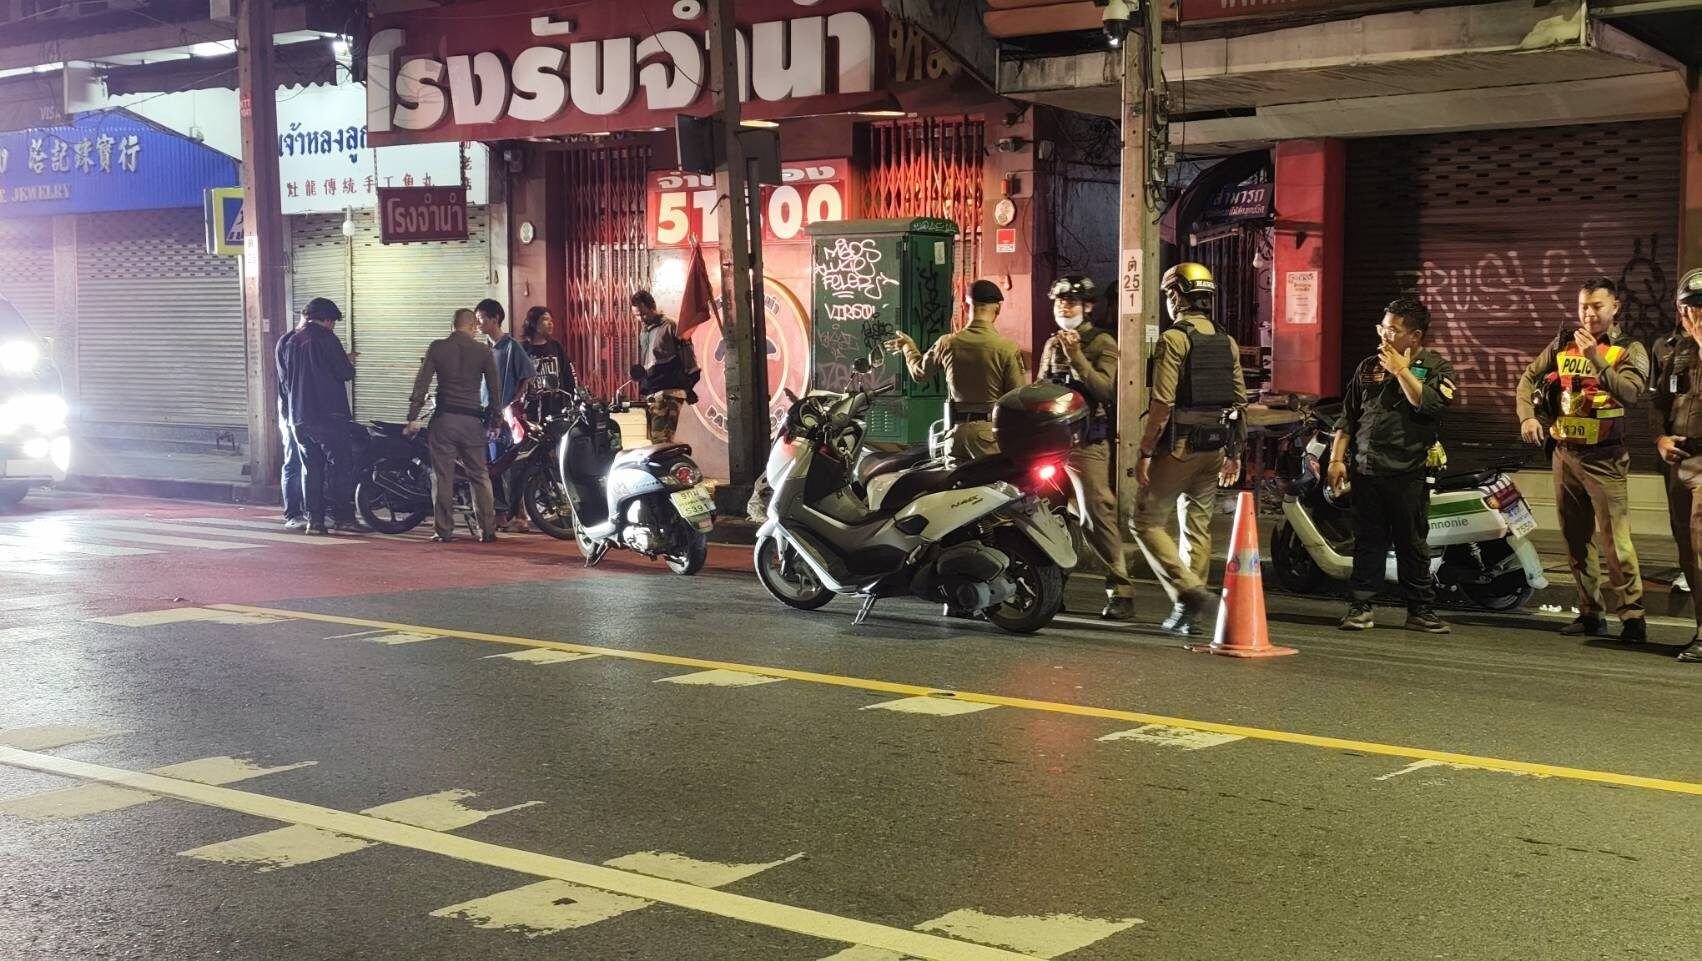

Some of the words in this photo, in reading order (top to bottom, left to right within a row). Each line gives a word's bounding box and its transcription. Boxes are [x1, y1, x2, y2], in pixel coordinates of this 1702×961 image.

[11, 183, 71, 202] JEWELRY
[387, 192, 463, 234] โรงจำนำ
[657, 183, 842, 245] 5100
[1123, 274, 1140, 289] 25
[1129, 293, 1134, 307] 1
[1562, 358, 1592, 374] POLIC
[1430, 516, 1469, 530] nnonie
